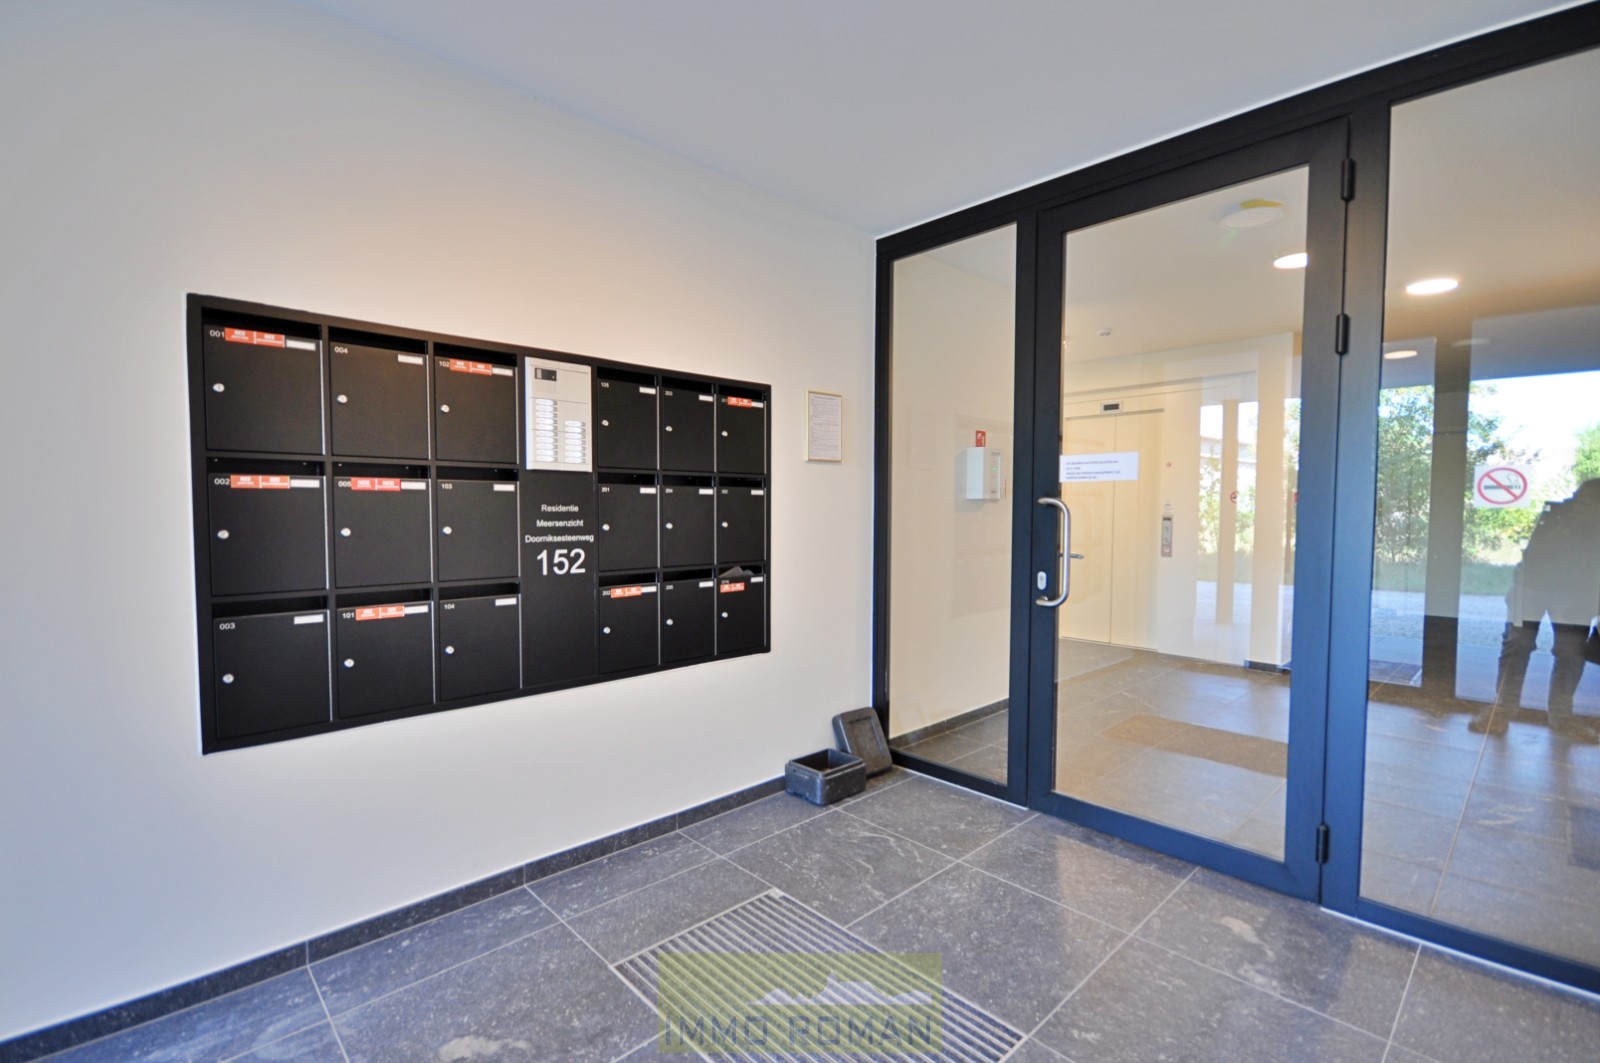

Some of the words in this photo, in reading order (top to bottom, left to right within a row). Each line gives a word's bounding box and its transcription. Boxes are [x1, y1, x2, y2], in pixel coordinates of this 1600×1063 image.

[209, 329, 224, 338] 001
[334, 346, 348, 354] 004
[439, 360, 450, 368] 102
[214, 477, 231, 486] 002
[540, 504, 580, 513] Residentie
[535, 519, 585, 528] Meersenzicht
[524, 533, 595, 544] Doorniksesteenweg
[536, 548, 587, 577] 152
[341, 611, 355, 620] 101
[219, 622, 236, 631] 003
